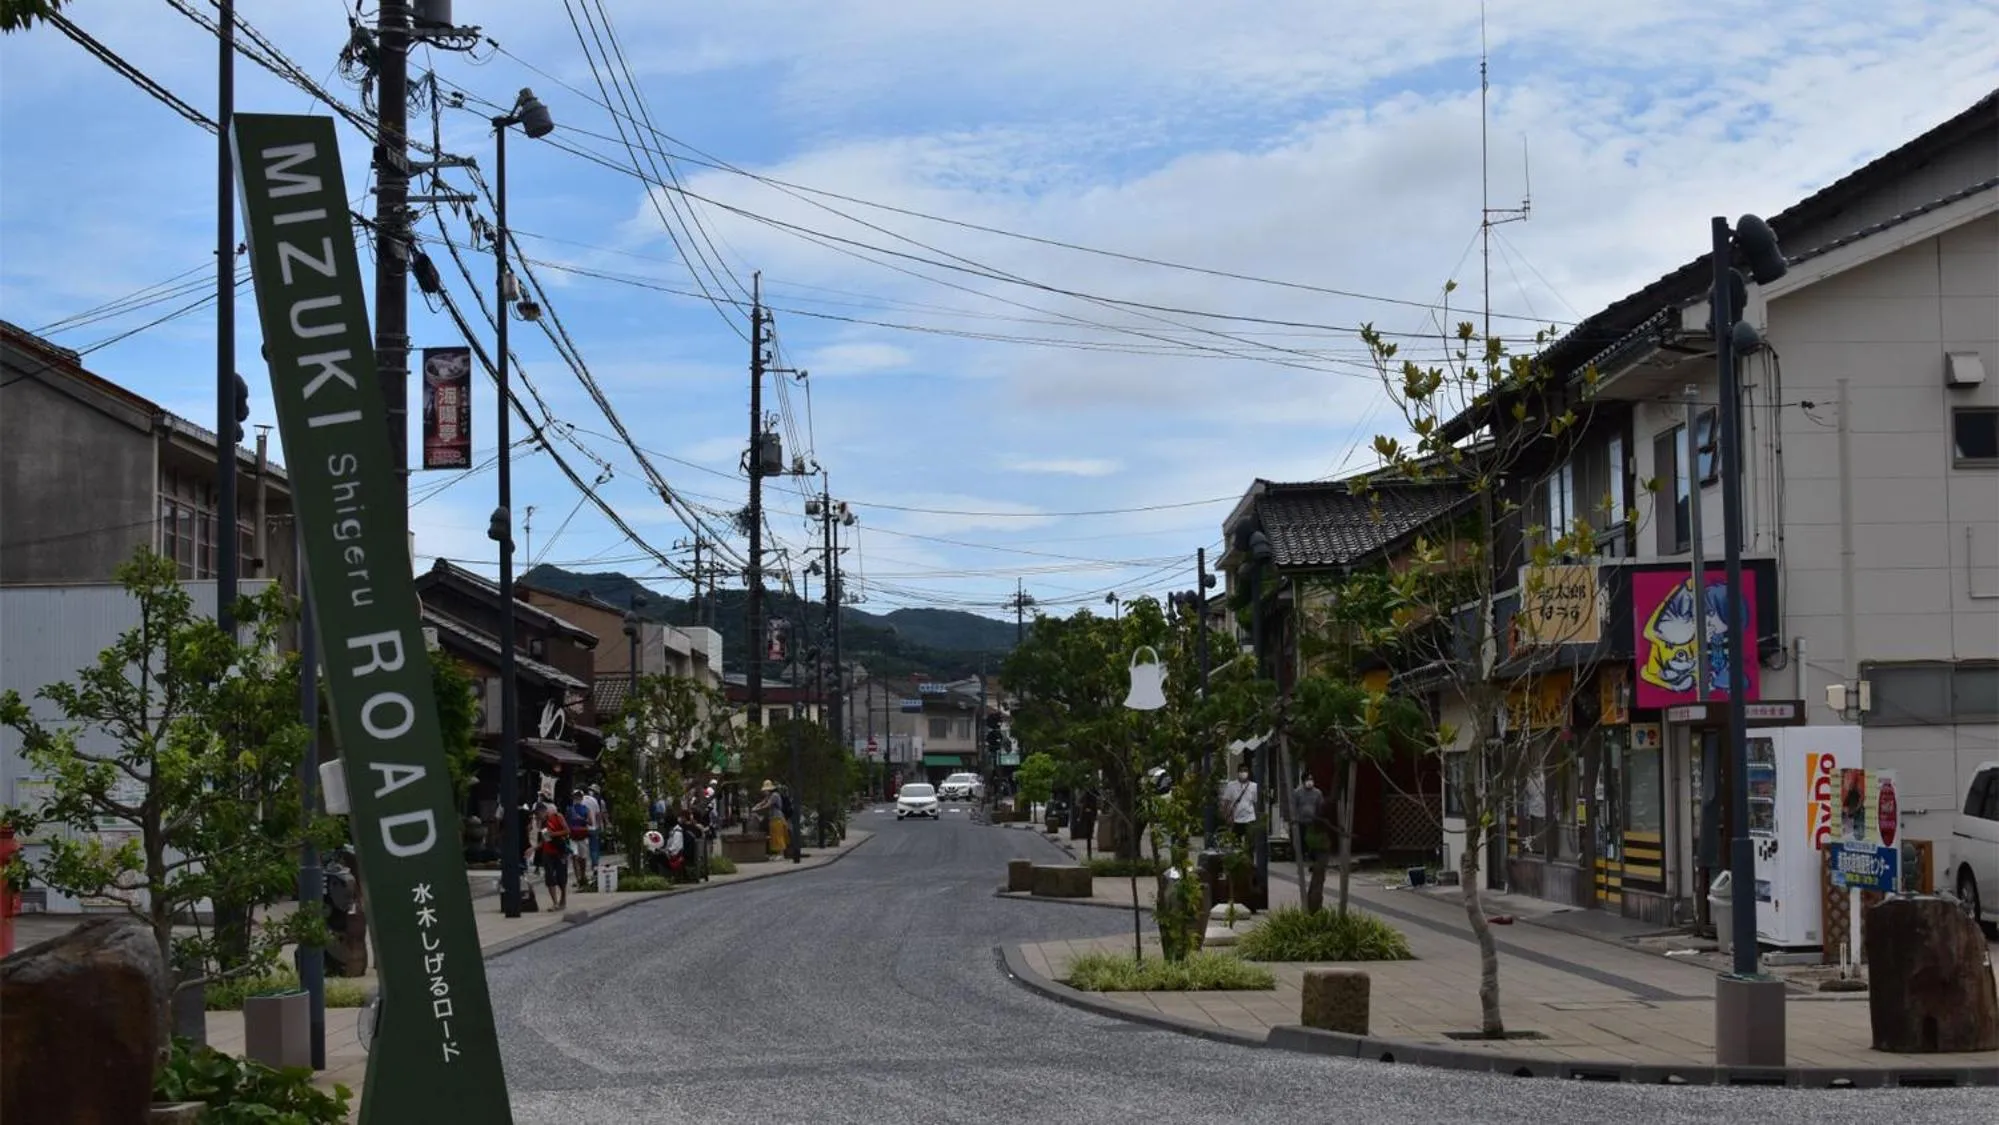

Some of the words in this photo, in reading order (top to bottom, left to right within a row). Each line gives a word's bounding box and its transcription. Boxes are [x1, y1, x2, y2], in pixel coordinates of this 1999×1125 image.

[261, 142, 363, 428] MIZUKI
[328, 453, 373, 607] Shigeru
[347, 630, 436, 857] ROAD
[411, 883, 460, 1063] 水木しげるロード
